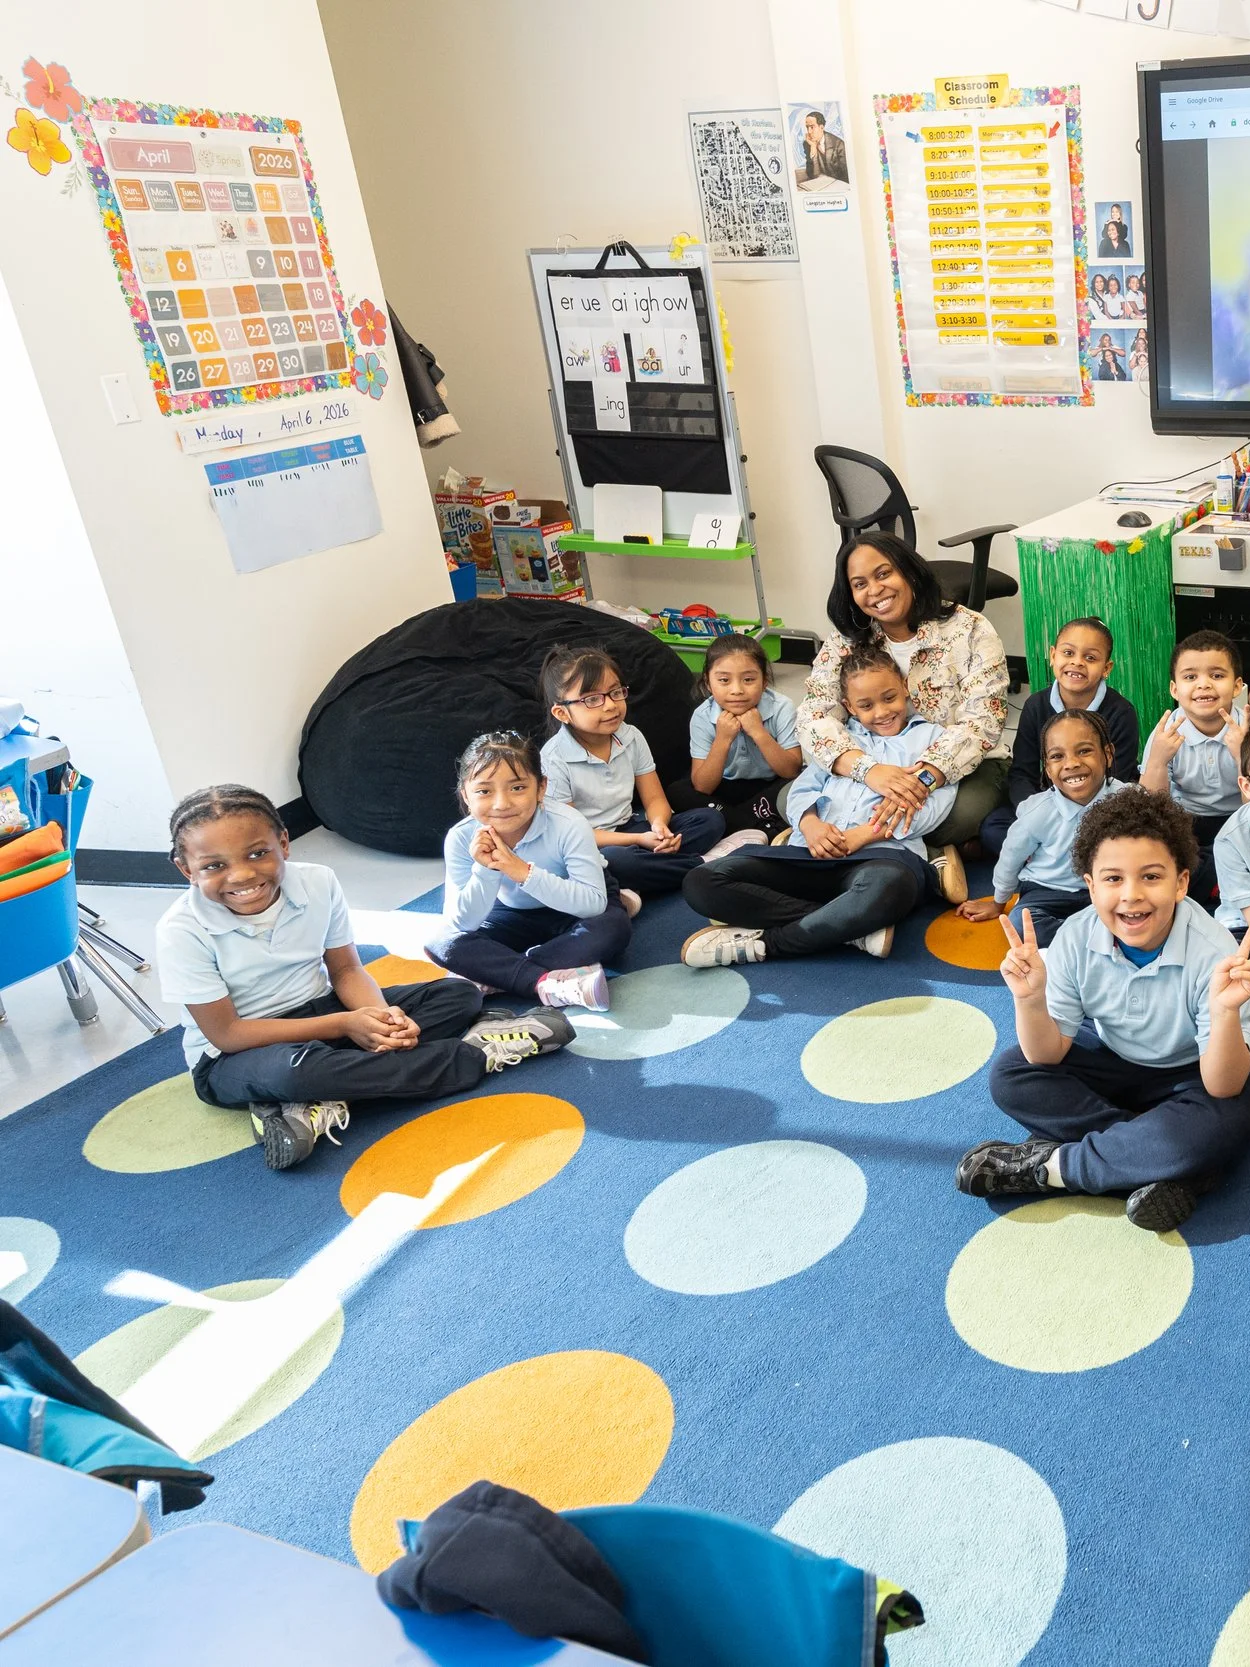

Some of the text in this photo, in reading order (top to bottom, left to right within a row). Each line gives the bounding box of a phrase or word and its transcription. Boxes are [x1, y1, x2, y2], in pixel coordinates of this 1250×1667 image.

[944, 80, 999, 92] Classroom
[948, 94, 997, 106] Schedule
[1186, 97, 1207, 105] Google
[137, 147, 292, 169] April 2026
[123, 185, 140, 196] Sun.
[151, 187, 171, 197] Mon.
[180, 187, 199, 197] Tues.
[208, 187, 225, 197] Wed.
[298, 222, 308, 236] 4
[176, 256, 314, 273] 6 9 10 11
[156, 288, 324, 312] 12 18
[561, 286, 688, 324] er ue ai igh ow
[941, 316, 978, 325] 3:10-3:30
[165, 319, 335, 347] 19 20 21 22 23 24 25
[176, 355, 299, 383] 26 27 28 29 30
[565, 355, 584, 367] aw
[678, 365, 692, 377] ur
[280, 411, 303, 431] April
[305, 410, 313, 425] 6
[472, 499, 482, 507] 20
[505, 492, 515, 500] 20
[447, 507, 472, 528] Little
[563, 522, 573, 530] 20
[457, 520, 484, 538] Bites
